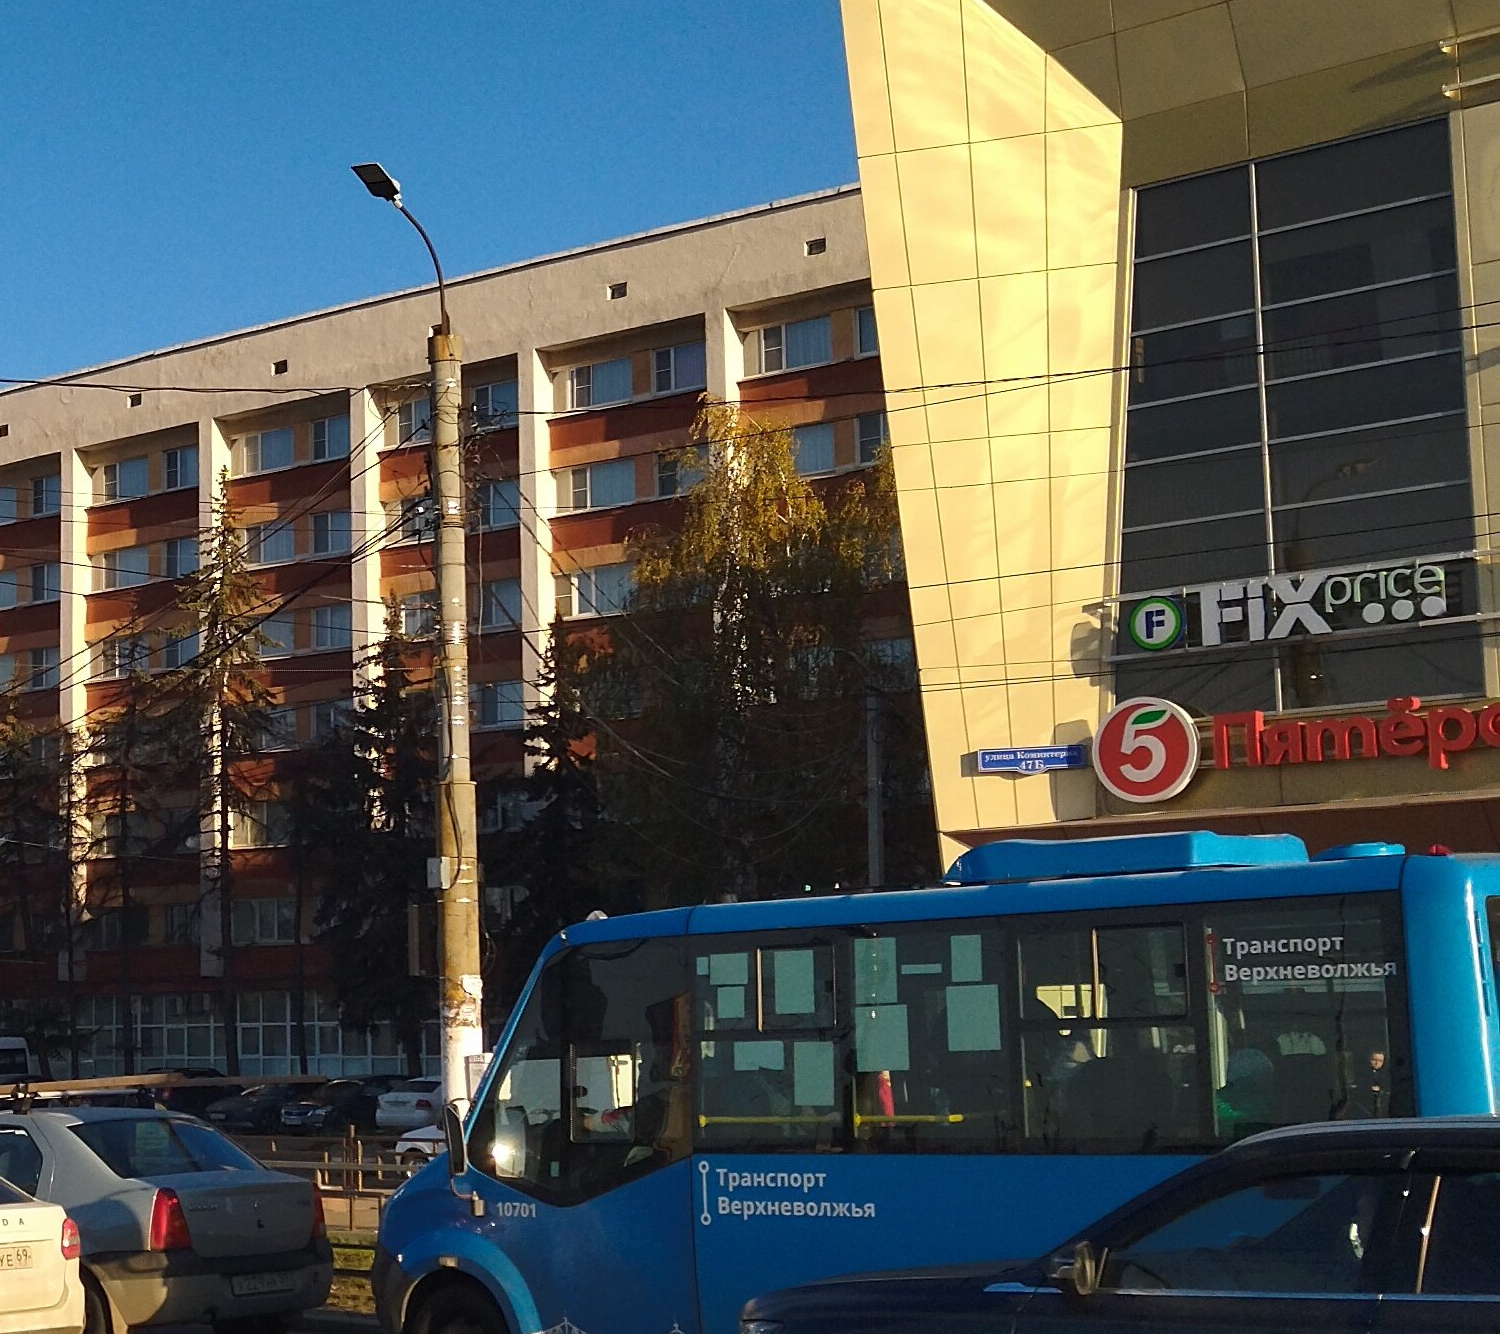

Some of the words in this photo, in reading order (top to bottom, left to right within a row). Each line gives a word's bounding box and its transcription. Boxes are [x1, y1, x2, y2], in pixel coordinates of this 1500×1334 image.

[1324, 565, 1447, 614] price
[984, 752, 1015, 763] улица
[1019, 759, 1045, 770] 47Б
[1222, 936, 1344, 960] Транспорт
[1224, 962, 1397, 985] Верхневолжья
[715, 1167, 827, 1193] Транспорт
[496, 1201, 538, 1219] 10701
[716, 1196, 876, 1219] Верхневолжья
